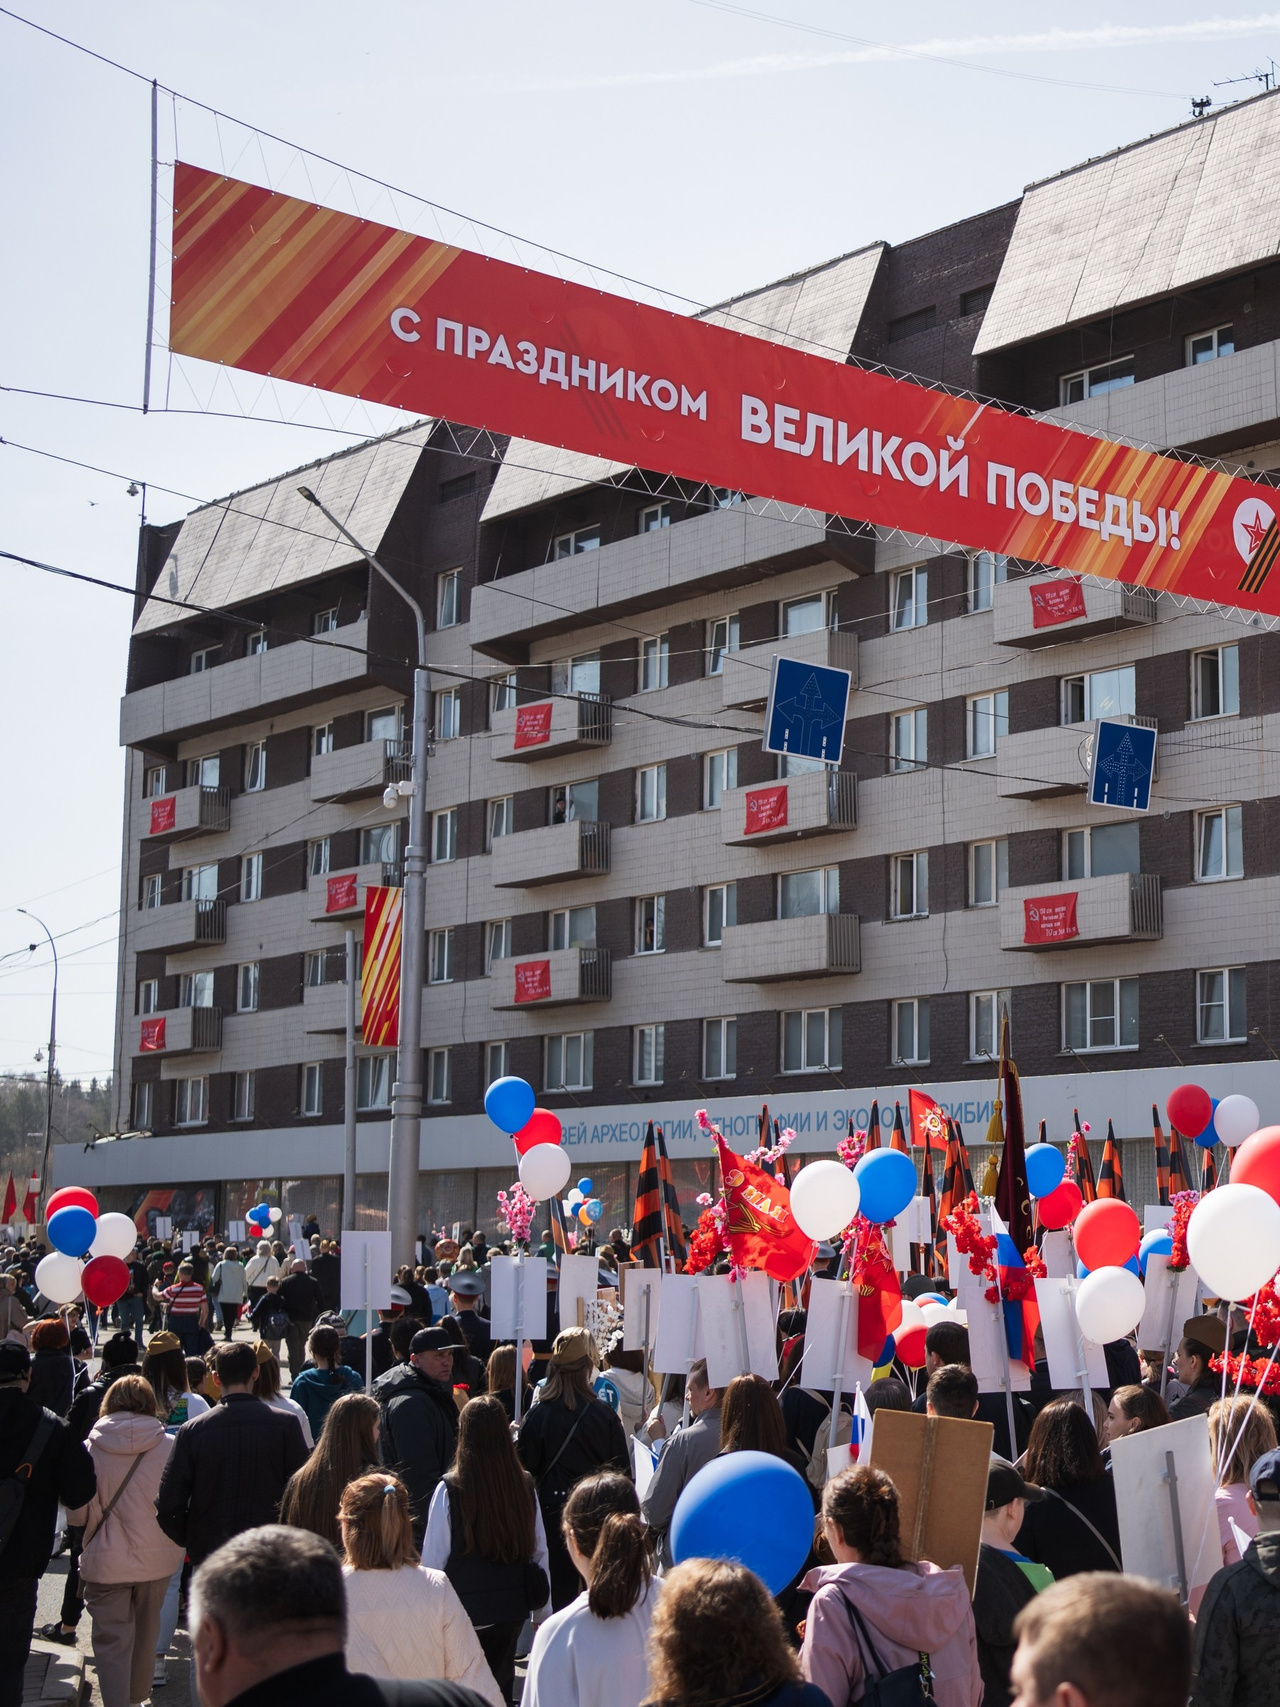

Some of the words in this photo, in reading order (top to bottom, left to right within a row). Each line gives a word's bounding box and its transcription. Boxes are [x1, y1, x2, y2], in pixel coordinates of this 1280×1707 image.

[390, 307, 421, 343] С
[436, 317, 707, 421] ПРАЗДНИКОМ
[741, 393, 969, 498] ВЕЛИКОЙ
[986, 461, 1180, 551] ПОБЕДЫ!
[560, 1121, 588, 1146] ЗЕЙ
[702, 1111, 812, 1138] ЭТНОГАФИИ
[816, 1105, 828, 1132] И
[940, 1100, 1007, 1124] СИБИ
